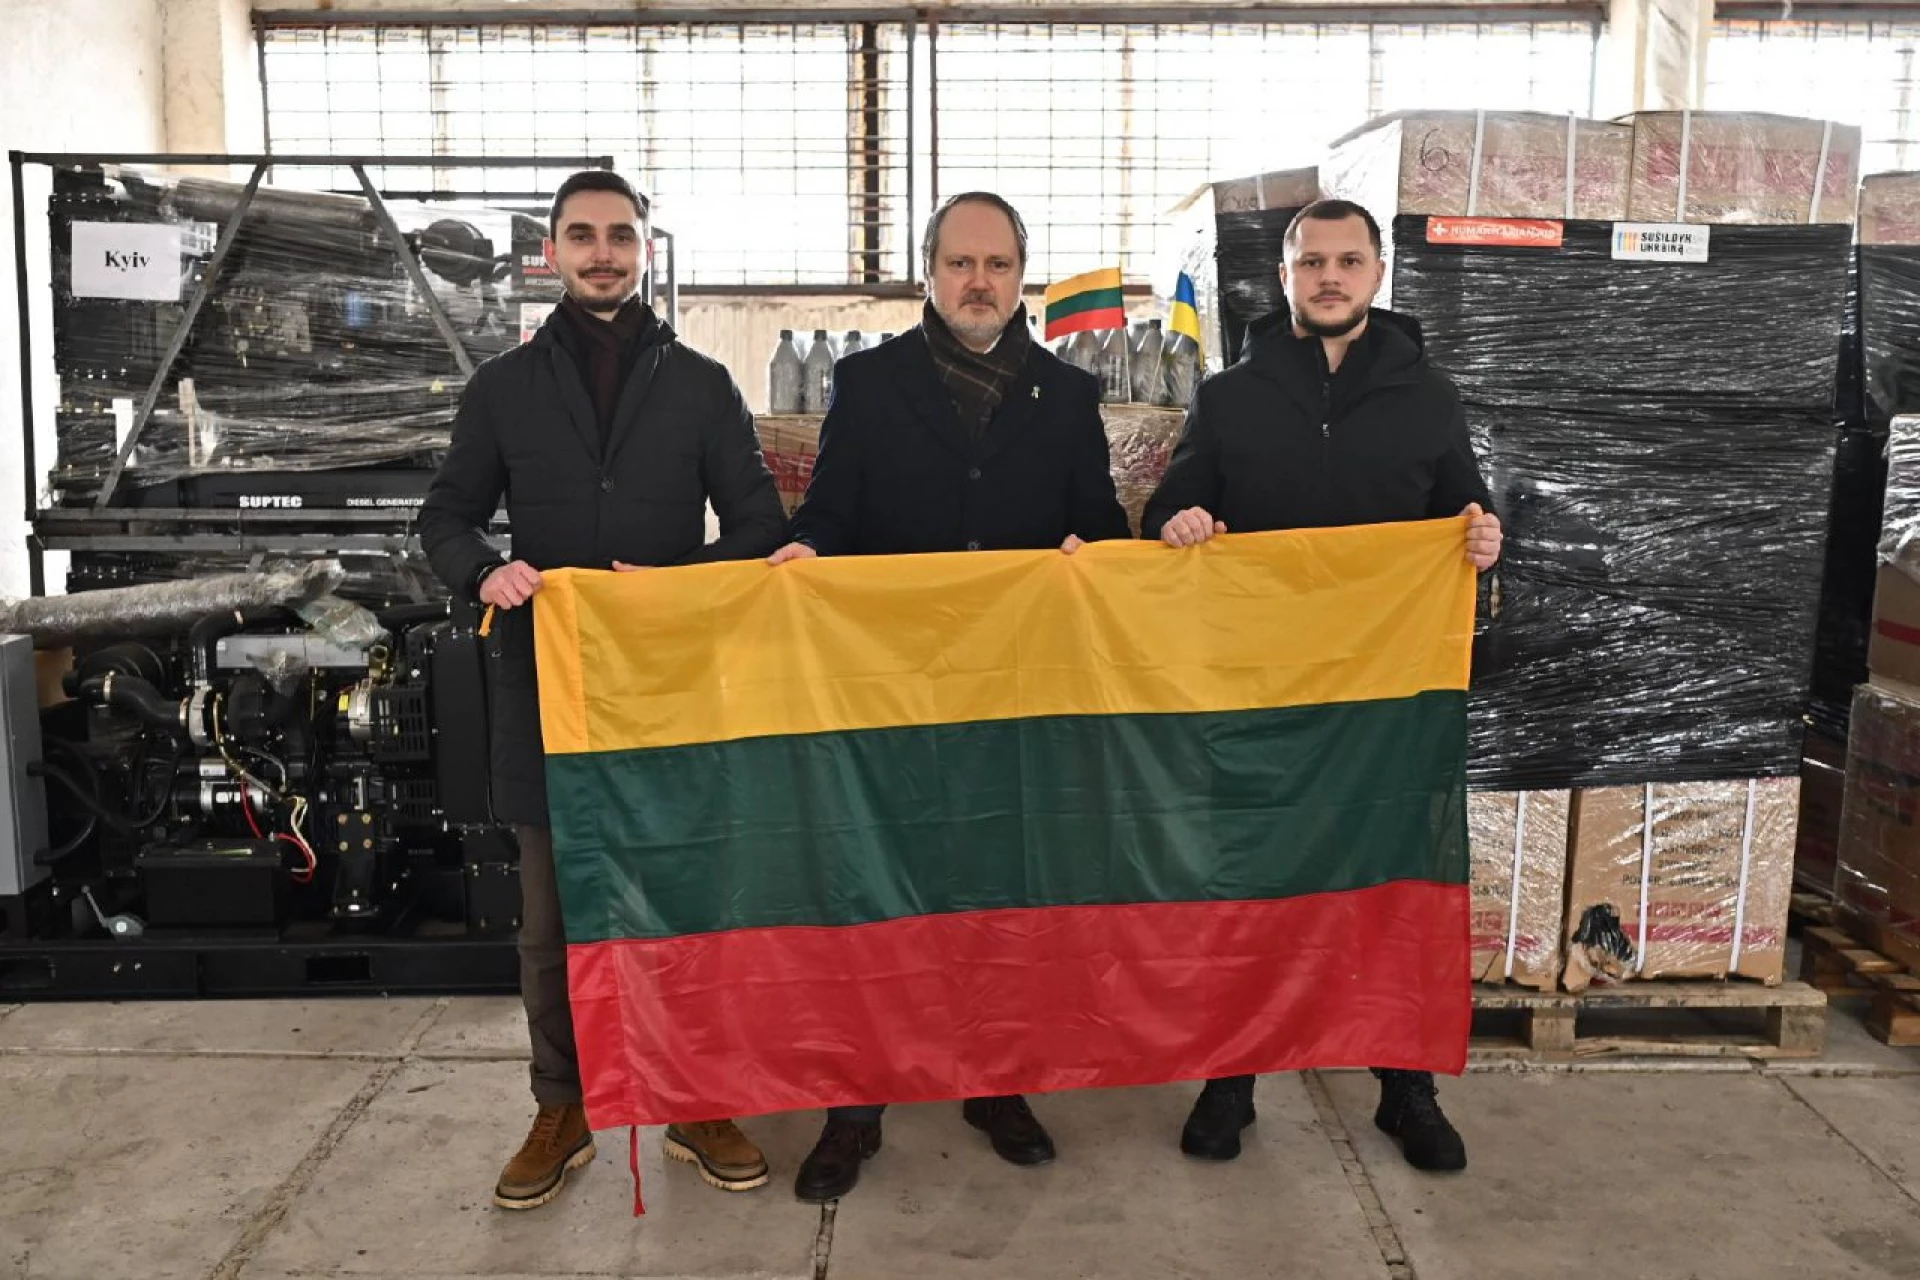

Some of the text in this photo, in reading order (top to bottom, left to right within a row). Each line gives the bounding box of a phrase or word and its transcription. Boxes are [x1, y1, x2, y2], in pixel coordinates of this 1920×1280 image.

[1420, 127, 1450, 172] 6
[104, 250, 151, 272] Kyiv
[239, 495, 302, 508] SUPTEC
[346, 498, 375, 507] DIESEL
